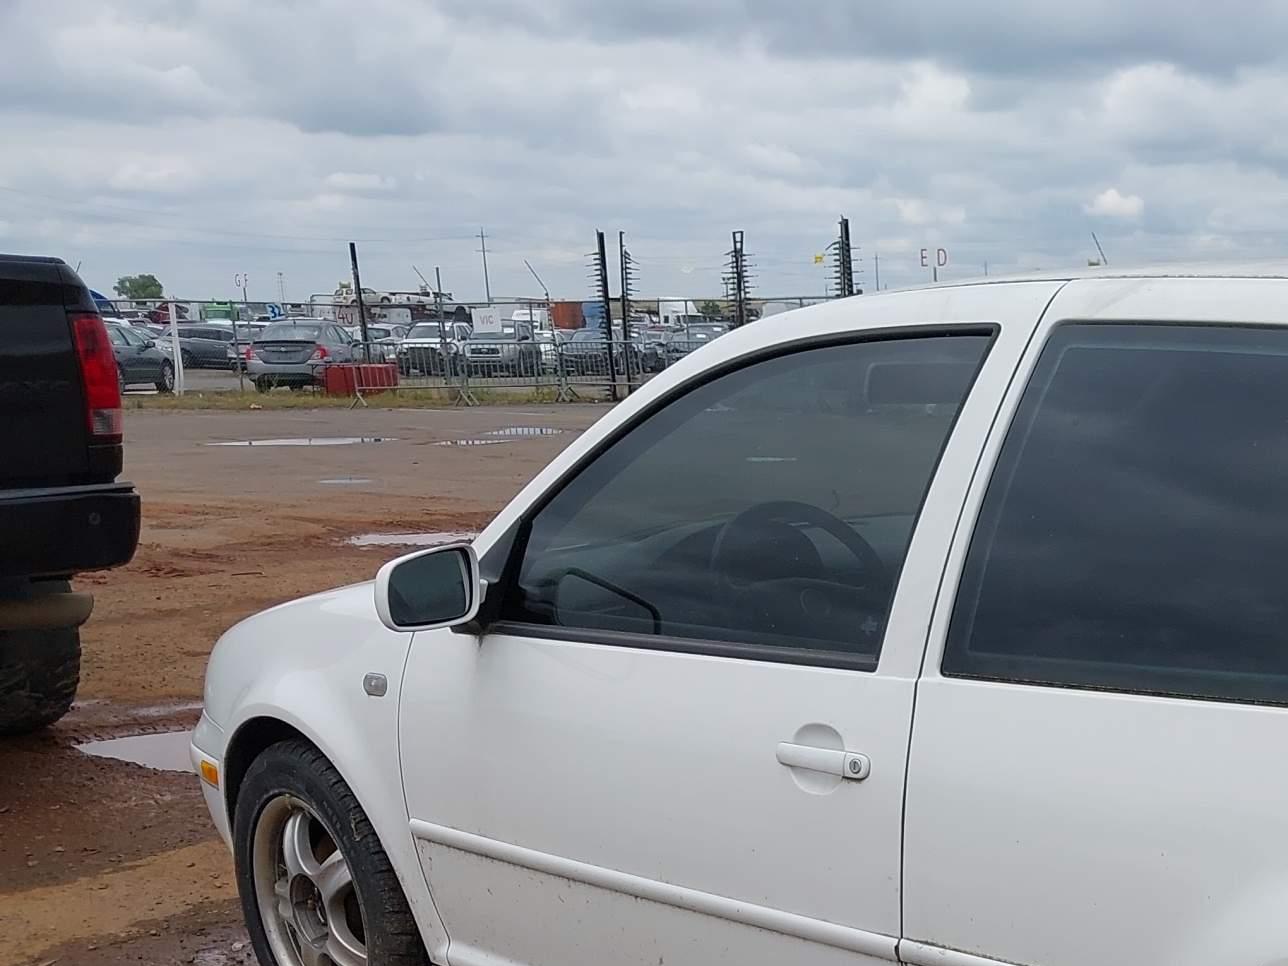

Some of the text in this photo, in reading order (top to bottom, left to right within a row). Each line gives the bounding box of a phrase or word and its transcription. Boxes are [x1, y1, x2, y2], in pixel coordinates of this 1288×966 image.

[920, 248, 948, 267] E D
[267, 304, 287, 319] 32
[479, 315, 495, 325] VIC
